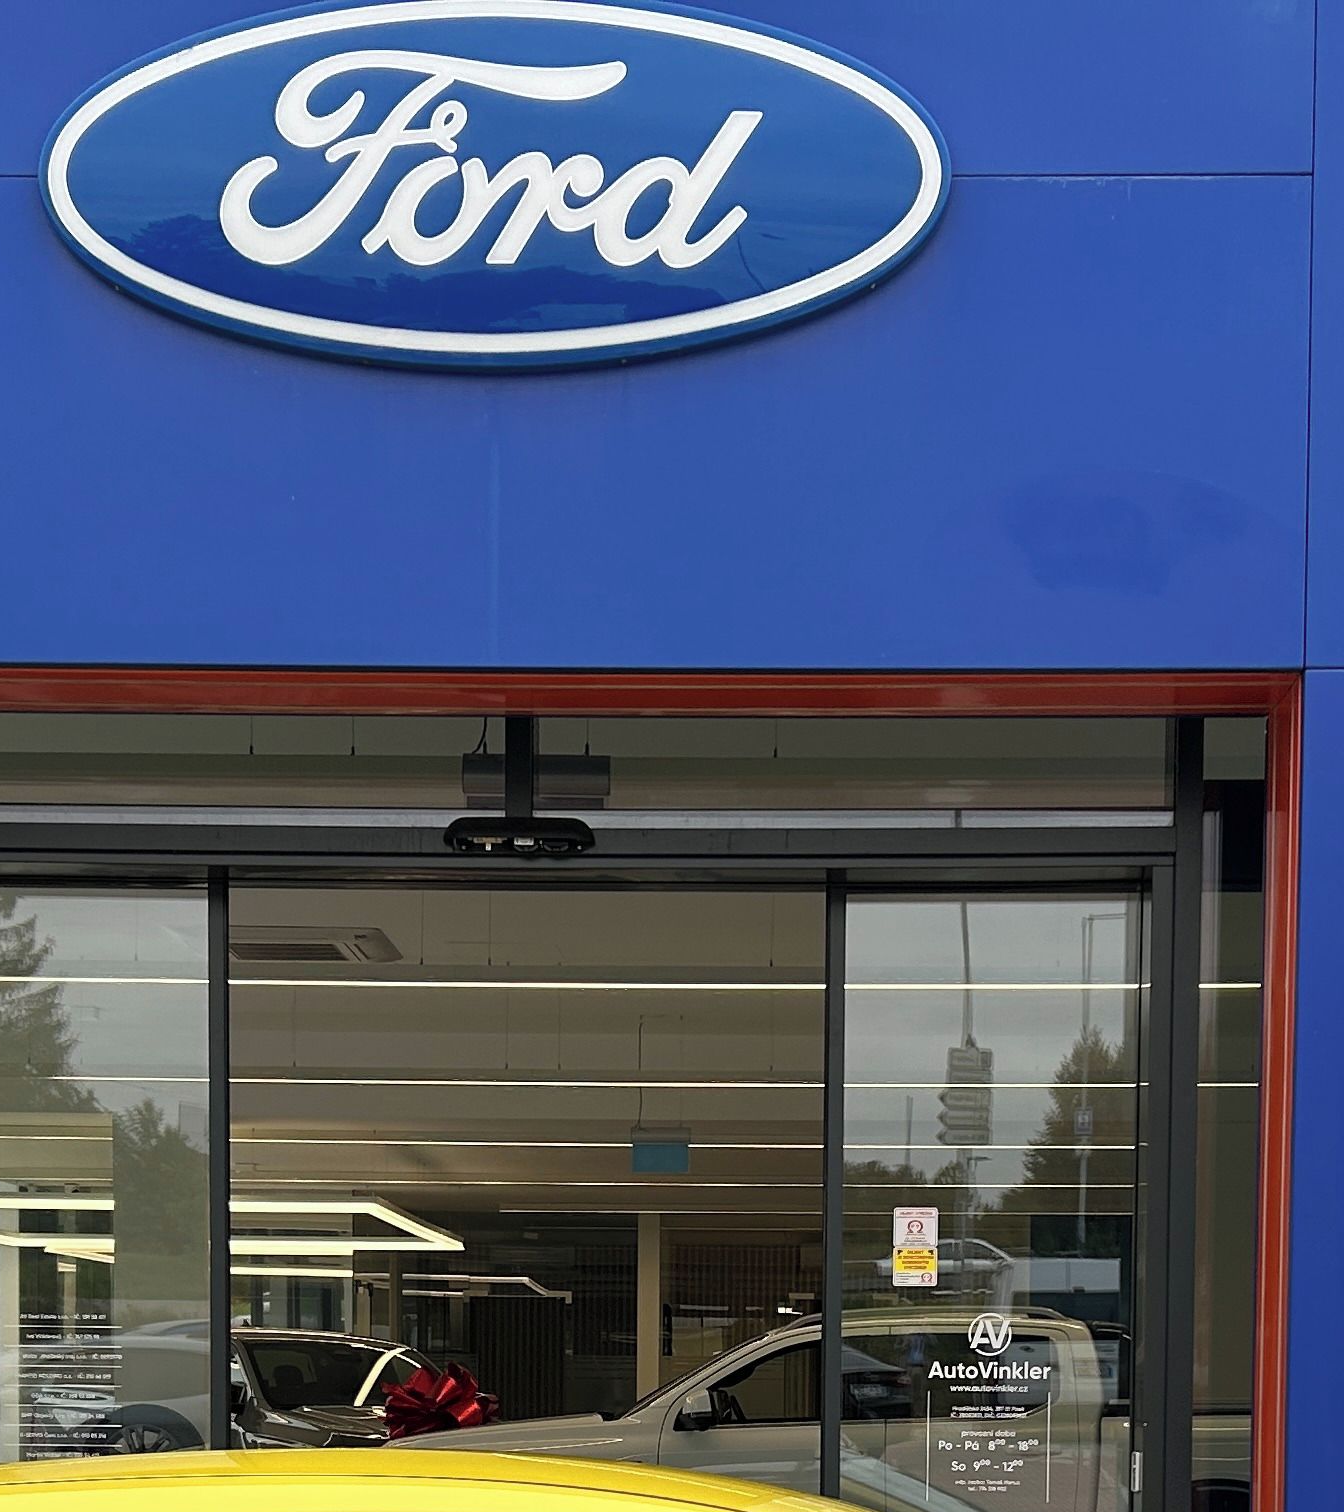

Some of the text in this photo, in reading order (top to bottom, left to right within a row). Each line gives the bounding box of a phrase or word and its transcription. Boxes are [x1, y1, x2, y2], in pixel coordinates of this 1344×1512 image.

[219, 49, 764, 270] Ford
[927, 1361, 1052, 1380] AutoVinkler
[951, 1461, 967, 1471] So
